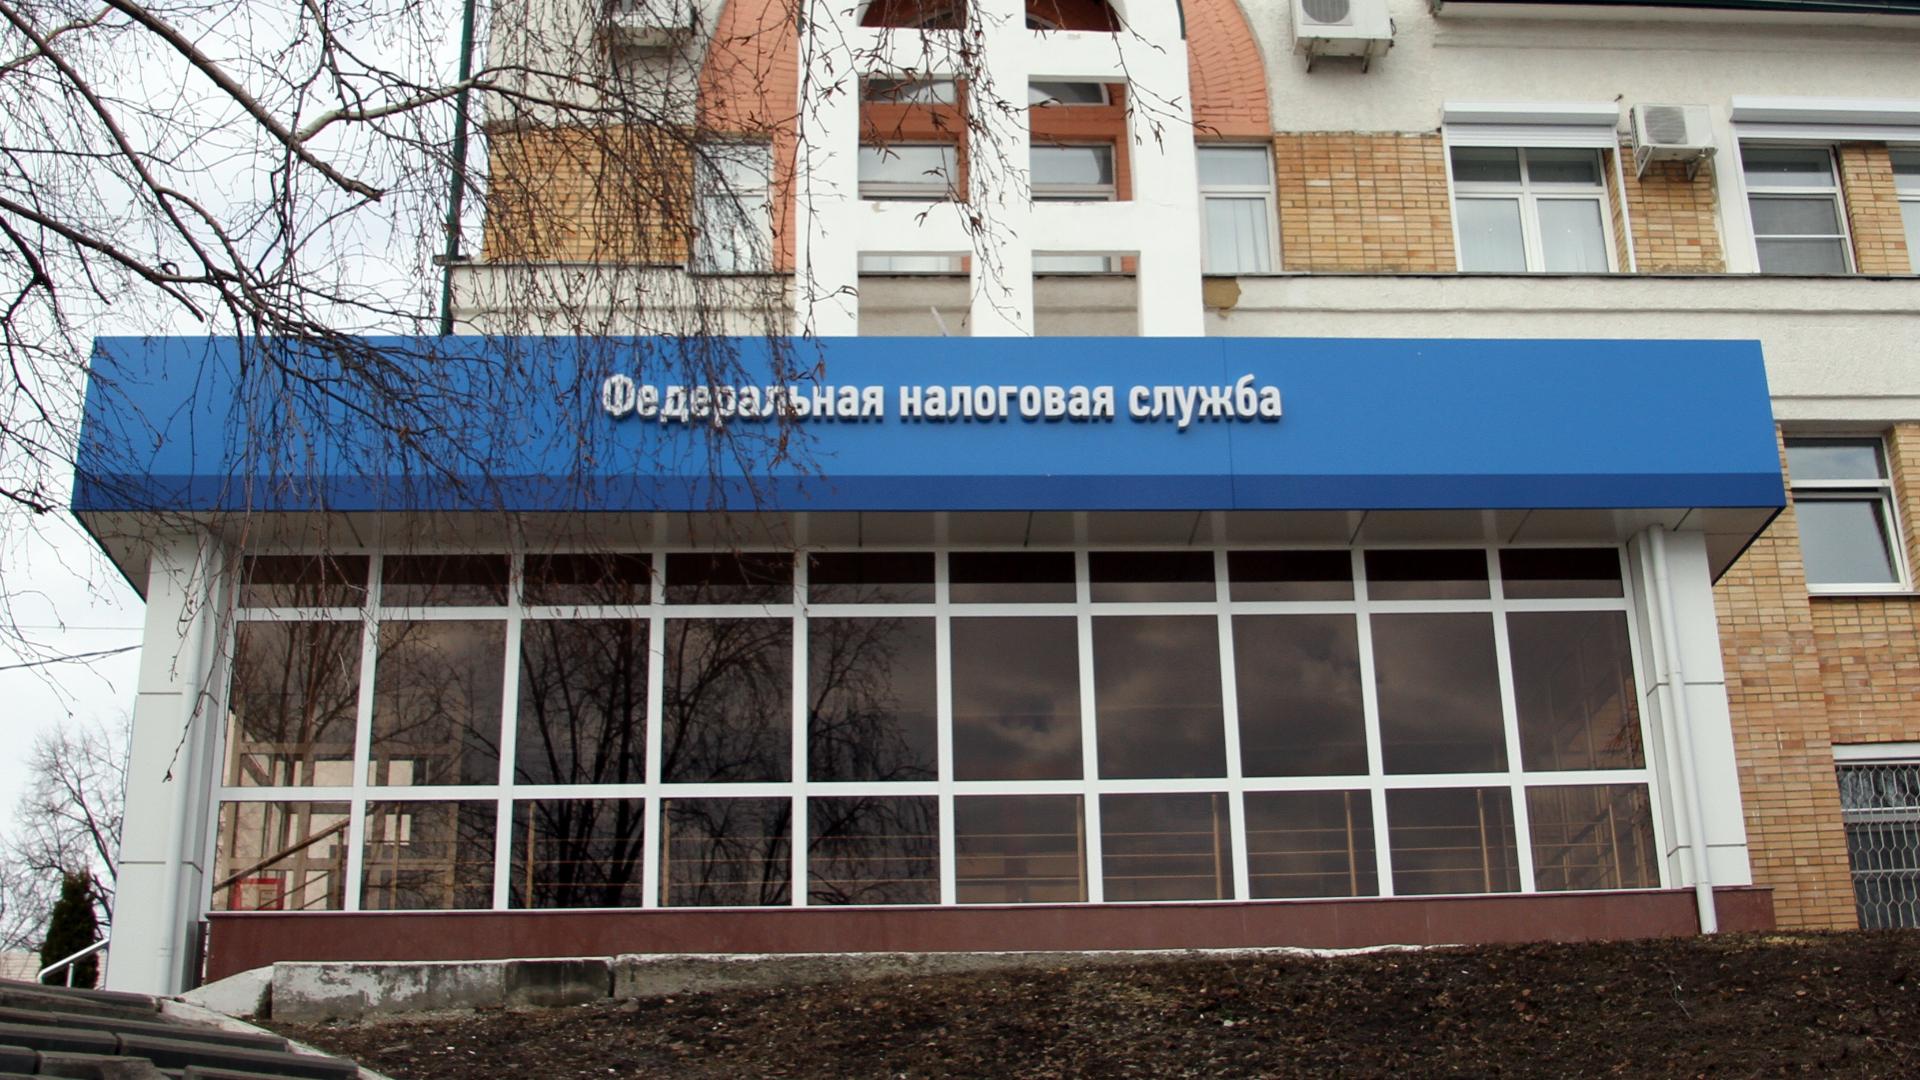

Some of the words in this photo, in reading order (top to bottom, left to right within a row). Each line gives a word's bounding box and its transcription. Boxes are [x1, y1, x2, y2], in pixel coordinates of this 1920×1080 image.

[602, 374, 884, 427] Федеральная
[898, 385, 1114, 418] налоговая
[1128, 374, 1282, 428] служба
